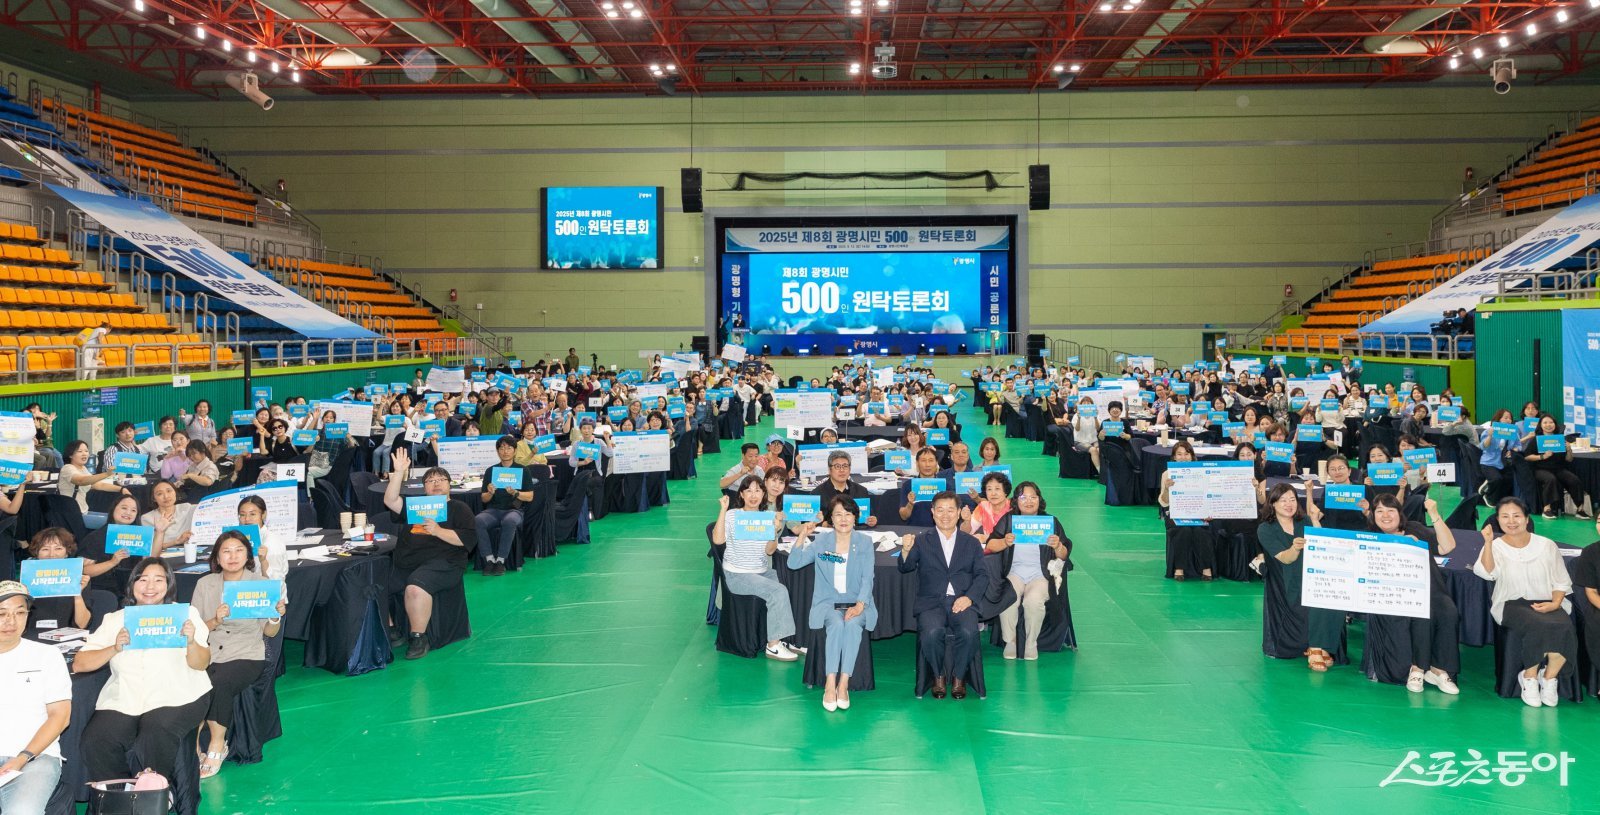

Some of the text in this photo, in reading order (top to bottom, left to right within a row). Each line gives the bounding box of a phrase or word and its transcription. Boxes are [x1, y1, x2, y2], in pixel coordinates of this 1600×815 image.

[588, 219, 648, 235] 원탁토론회
[759, 231, 798, 243] 2025년
[802, 231, 832, 243] 제8회
[835, 230, 880, 243] 광명시민
[918, 230, 976, 242] 원탁토론회
[1480, 233, 1581, 272] 500
[143, 244, 246, 280] 500
[782, 266, 849, 278] 제8회 광명시민
[990, 265, 999, 288] 시민
[731, 264, 741, 298] 광명형
[852, 290, 950, 313] 원탁토론회
[990, 292, 1000, 325] 공론의
[286, 468, 296, 477] 42
[1436, 468, 1446, 477] 44
[31, 577, 71, 586] 시작합니다
[232, 599, 270, 607] 시작합니다
[138, 617, 173, 628] 광명에서
[134, 626, 178, 637] 시작합니다
